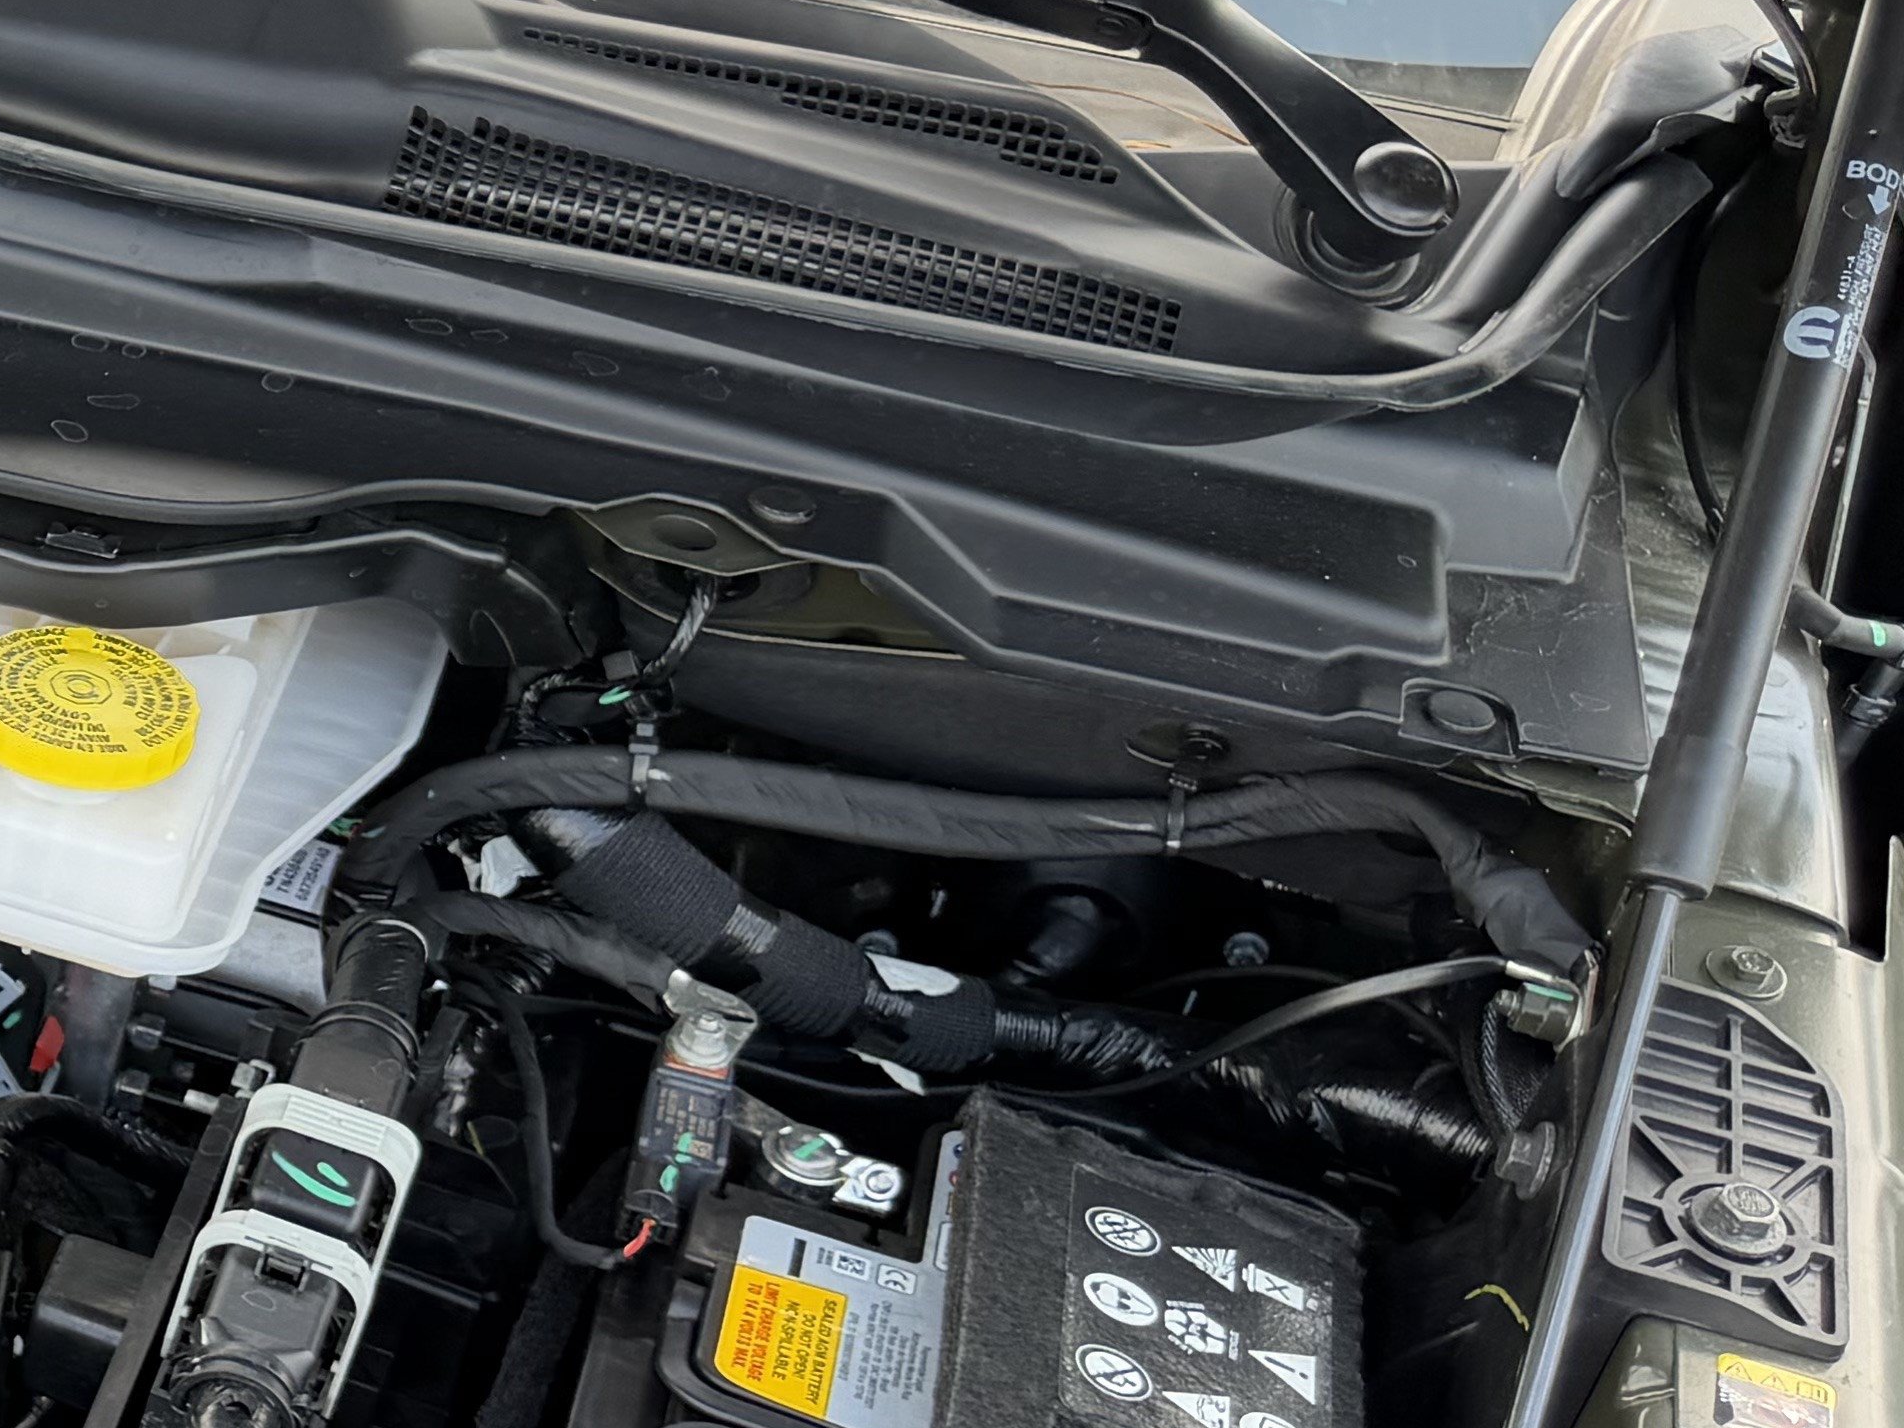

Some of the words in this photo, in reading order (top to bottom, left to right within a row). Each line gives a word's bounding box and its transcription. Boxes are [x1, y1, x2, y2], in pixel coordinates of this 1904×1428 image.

[1846, 159, 1904, 190] BOD
[746, 1282, 762, 1295] TO
[754, 1307, 774, 1343] CHARGE
[800, 1312, 815, 1330] DO
[817, 1298, 838, 1339] SEALED
[796, 1329, 812, 1349] NOT
[813, 1337, 830, 1359] AGM
[804, 1358, 825, 1405] BATTERY
